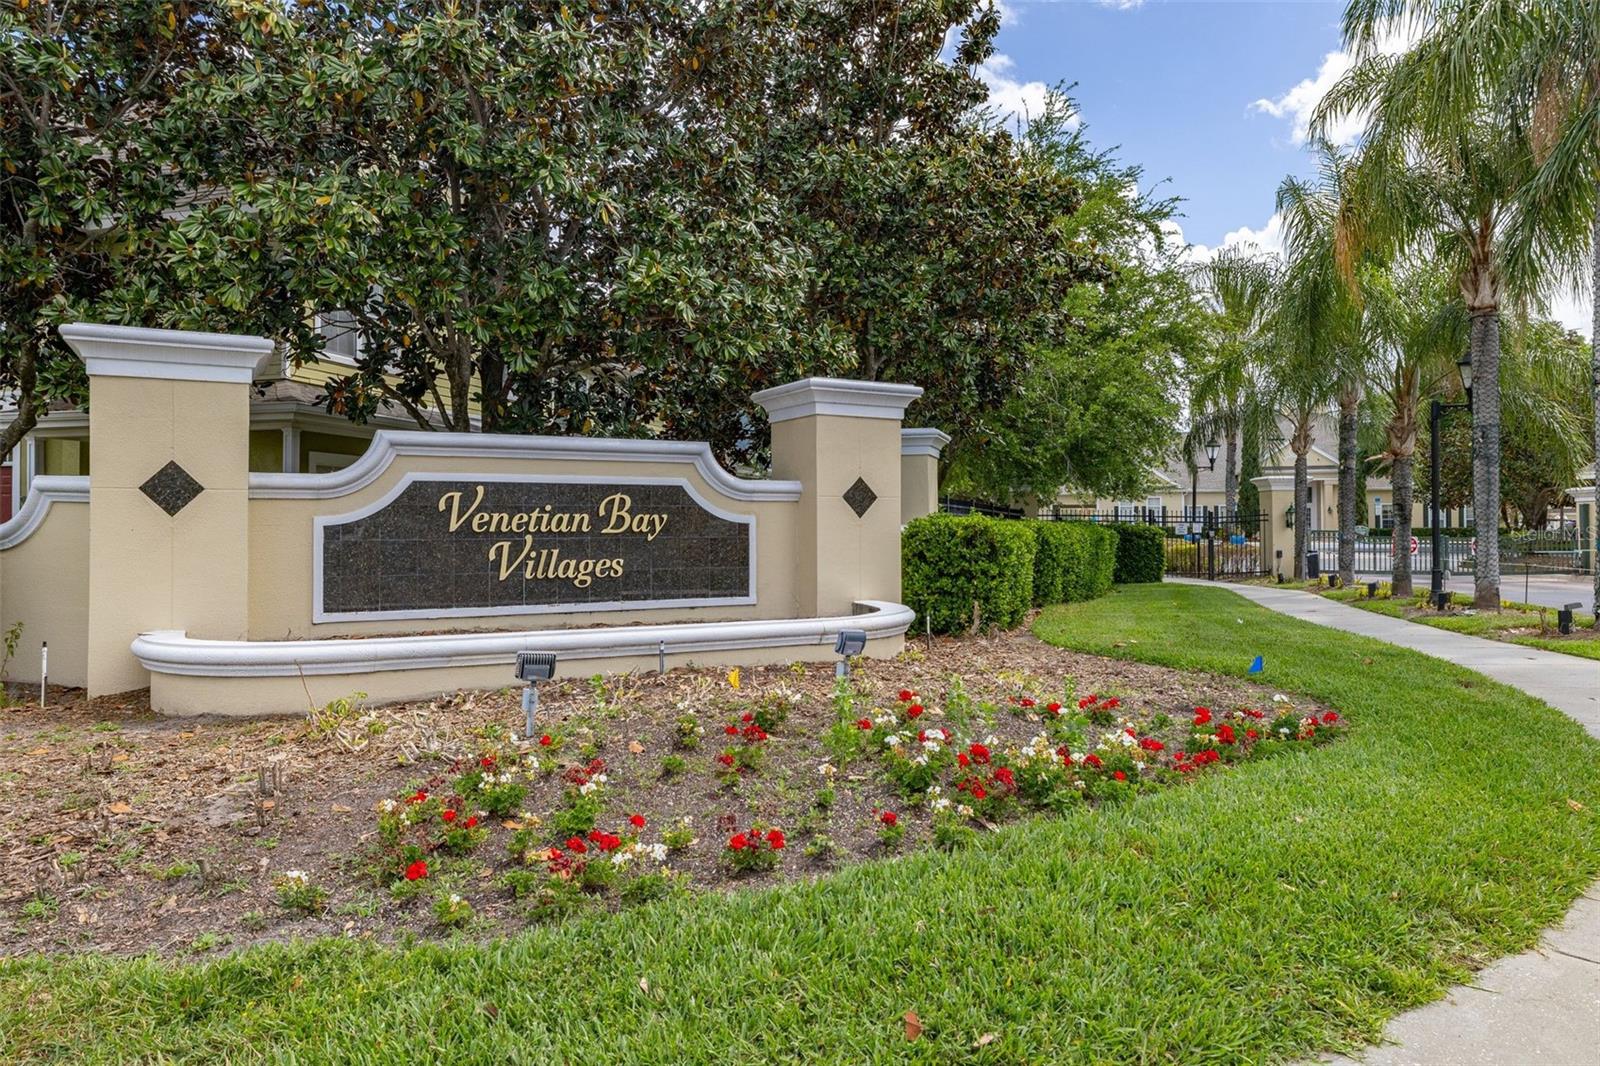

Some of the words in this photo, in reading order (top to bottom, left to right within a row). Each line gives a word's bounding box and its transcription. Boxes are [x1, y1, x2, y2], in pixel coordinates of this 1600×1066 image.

[438, 485, 592, 533] Venetian
[598, 492, 668, 541] Bay
[488, 534, 624, 588] Villages
